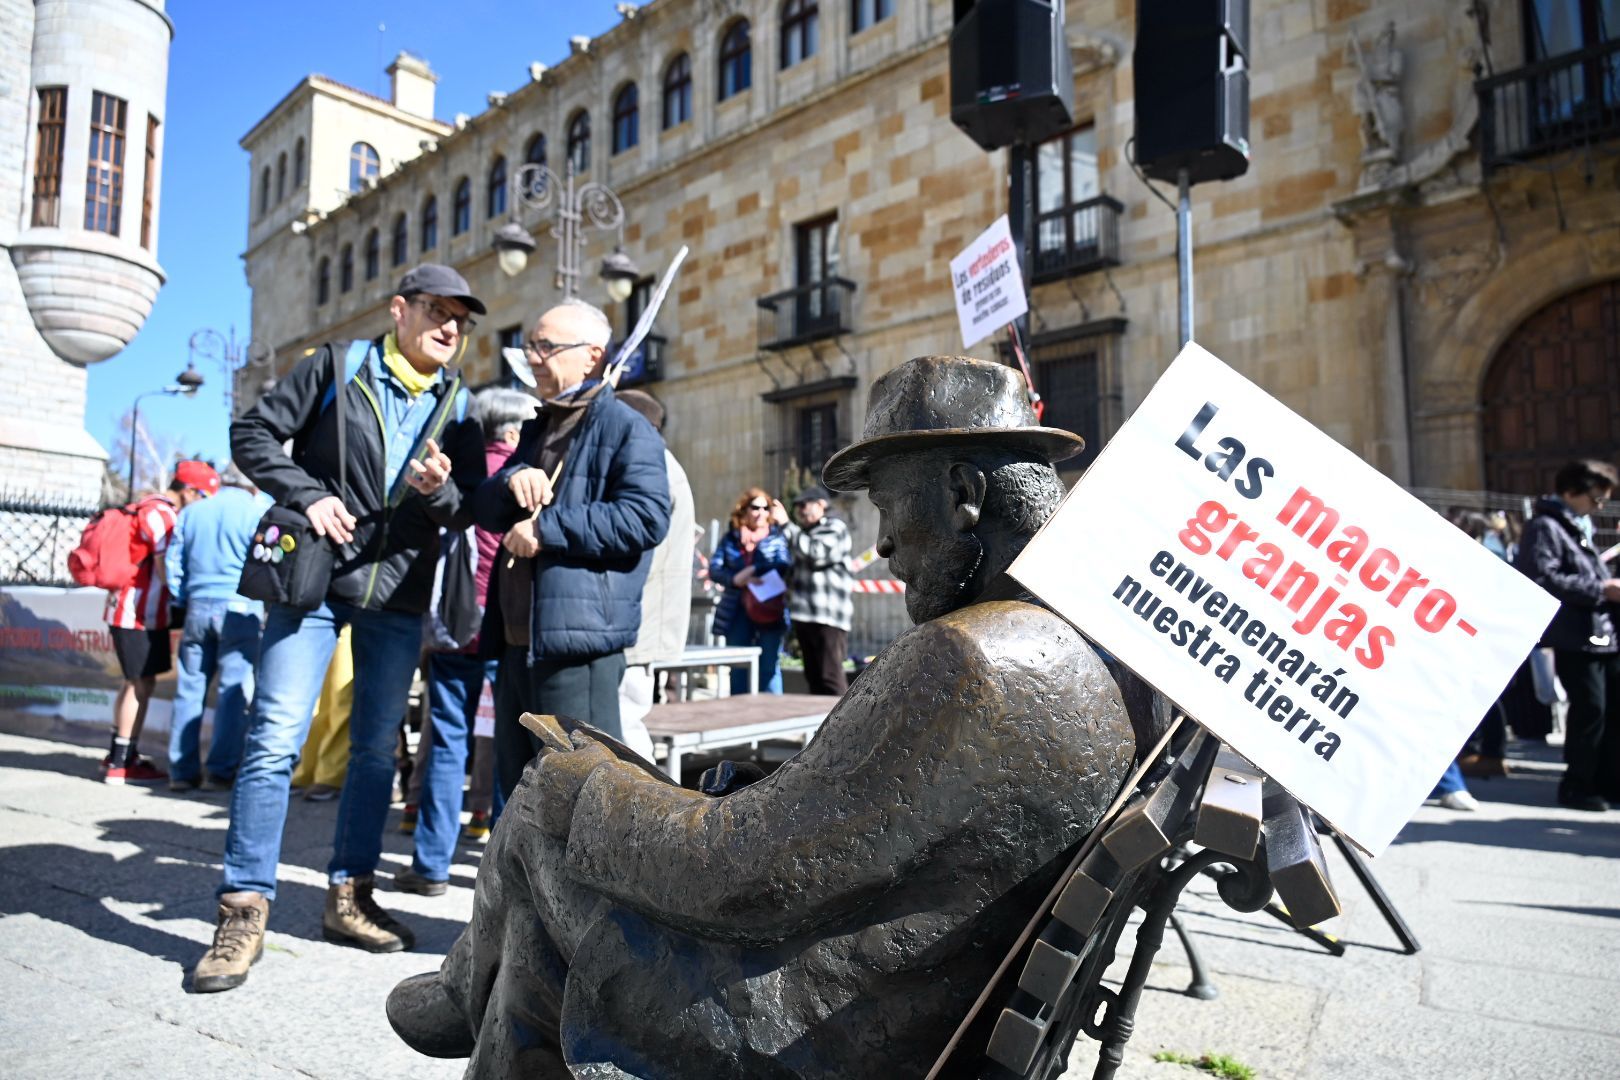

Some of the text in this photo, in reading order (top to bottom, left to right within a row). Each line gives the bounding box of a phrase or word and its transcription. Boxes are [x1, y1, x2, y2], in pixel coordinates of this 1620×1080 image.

[1174, 401, 1478, 637] Las macro-
[1178, 500, 1395, 670] granjas
[1112, 574, 1342, 762] nuestra tierra
[1149, 550, 1360, 720] envenenarán
